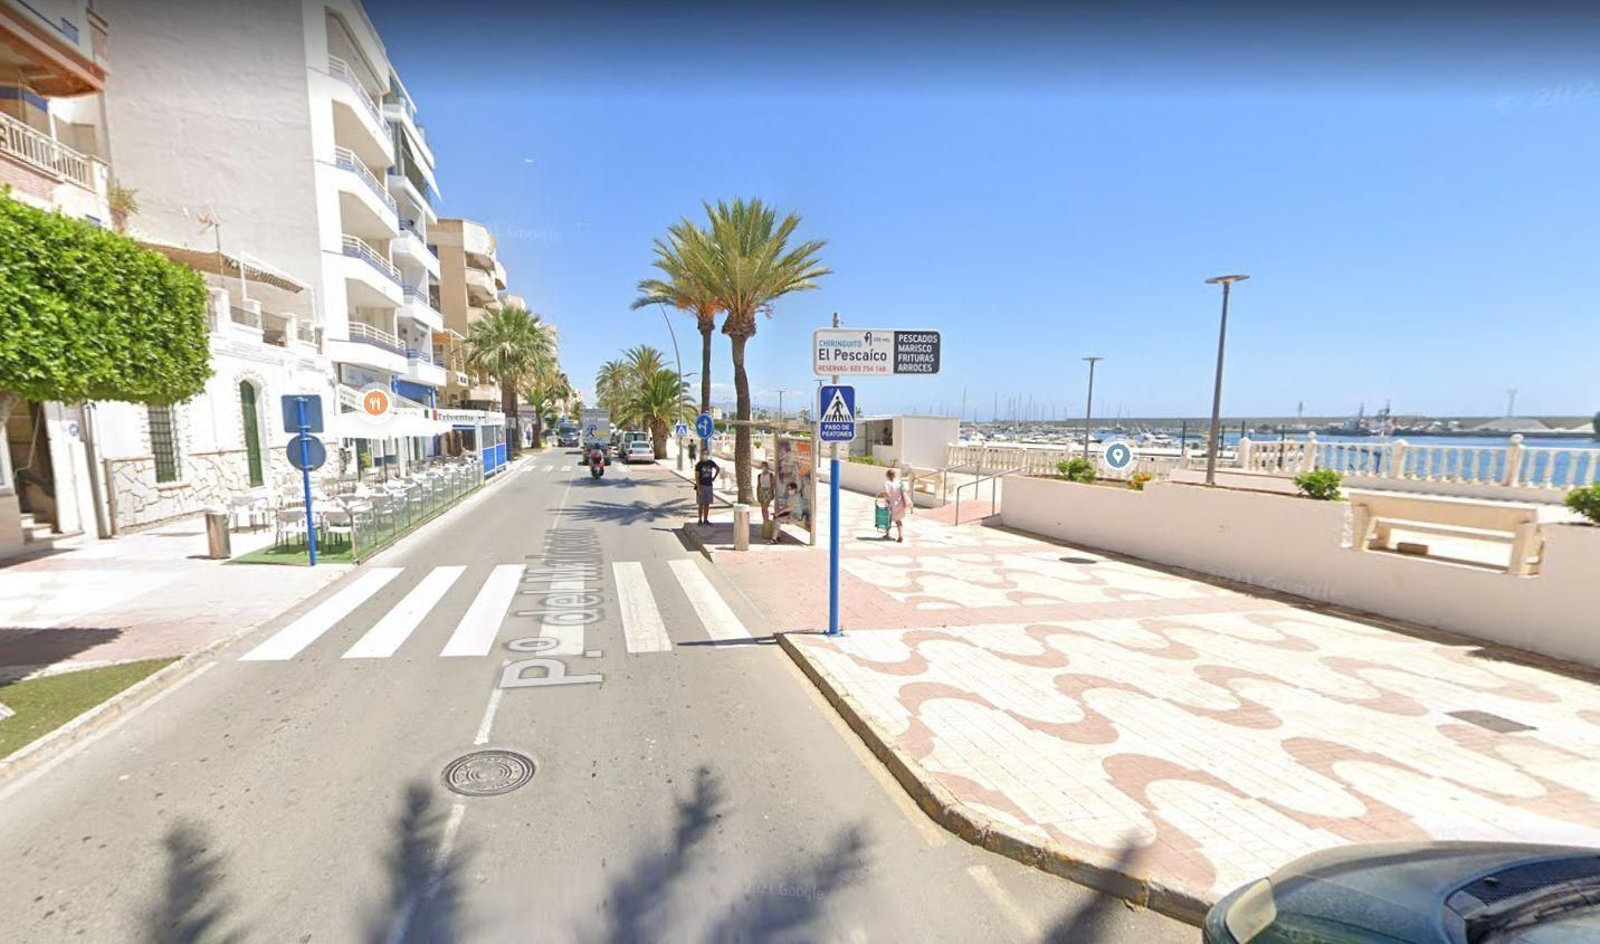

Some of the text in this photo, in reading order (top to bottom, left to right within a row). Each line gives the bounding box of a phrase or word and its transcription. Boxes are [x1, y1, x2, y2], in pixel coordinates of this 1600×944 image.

[898, 334, 938, 344] PESCADOS
[819, 340, 862, 348] CHIRINGUITO
[898, 344, 932, 353] MARISCO
[819, 348, 887, 361] El Pescaíco
[898, 354, 935, 363] FRITURAS
[897, 363, 932, 373] ARROCES
